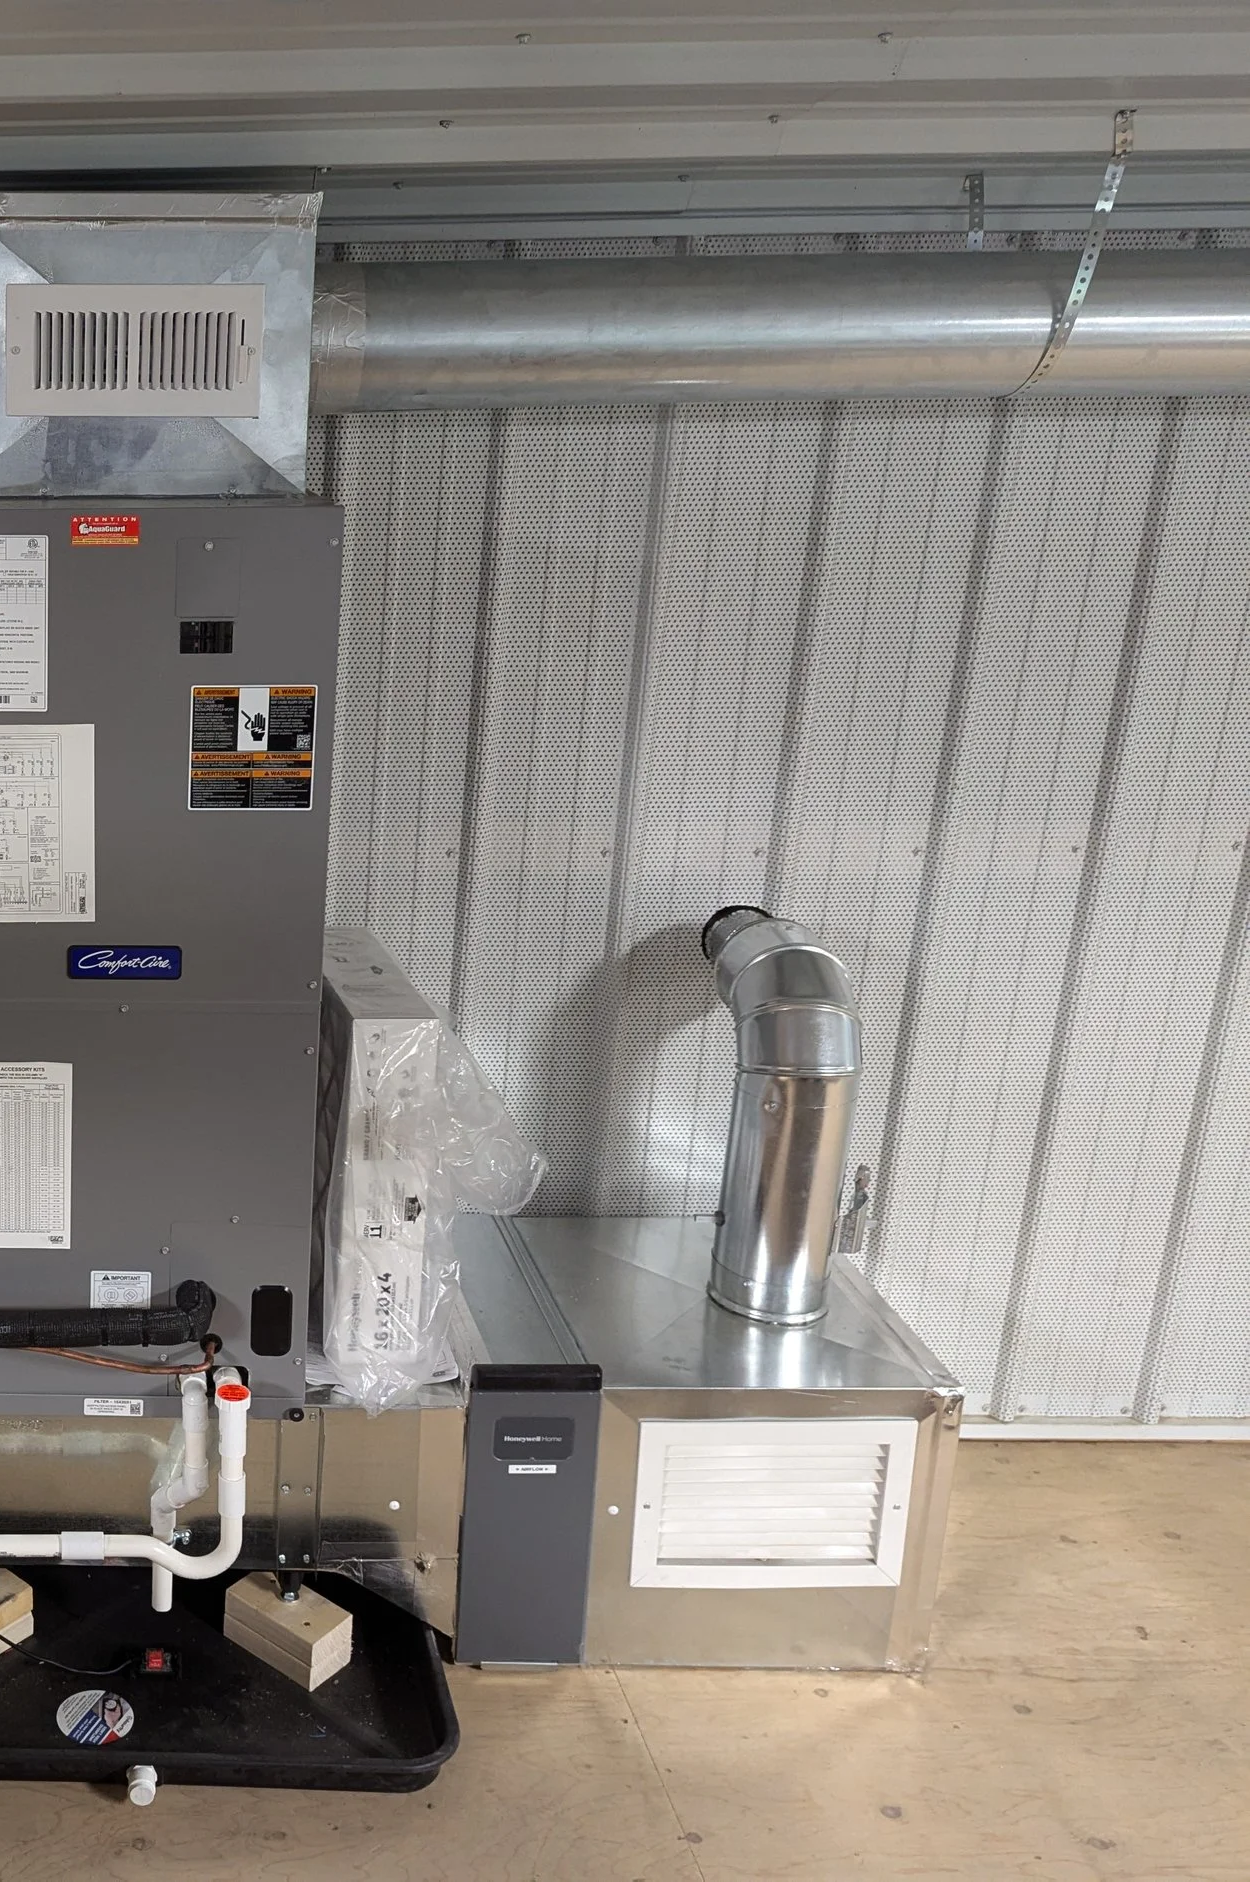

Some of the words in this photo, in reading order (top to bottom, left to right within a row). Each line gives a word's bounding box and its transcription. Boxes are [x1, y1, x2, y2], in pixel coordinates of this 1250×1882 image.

[88, 525, 126, 533] AquaGuard
[370, 1225, 382, 1238] 11
[377, 1273, 392, 1283] 4
[381, 1285, 391, 1294] x
[375, 1298, 390, 1316] 20
[374, 1332, 388, 1350] 16
